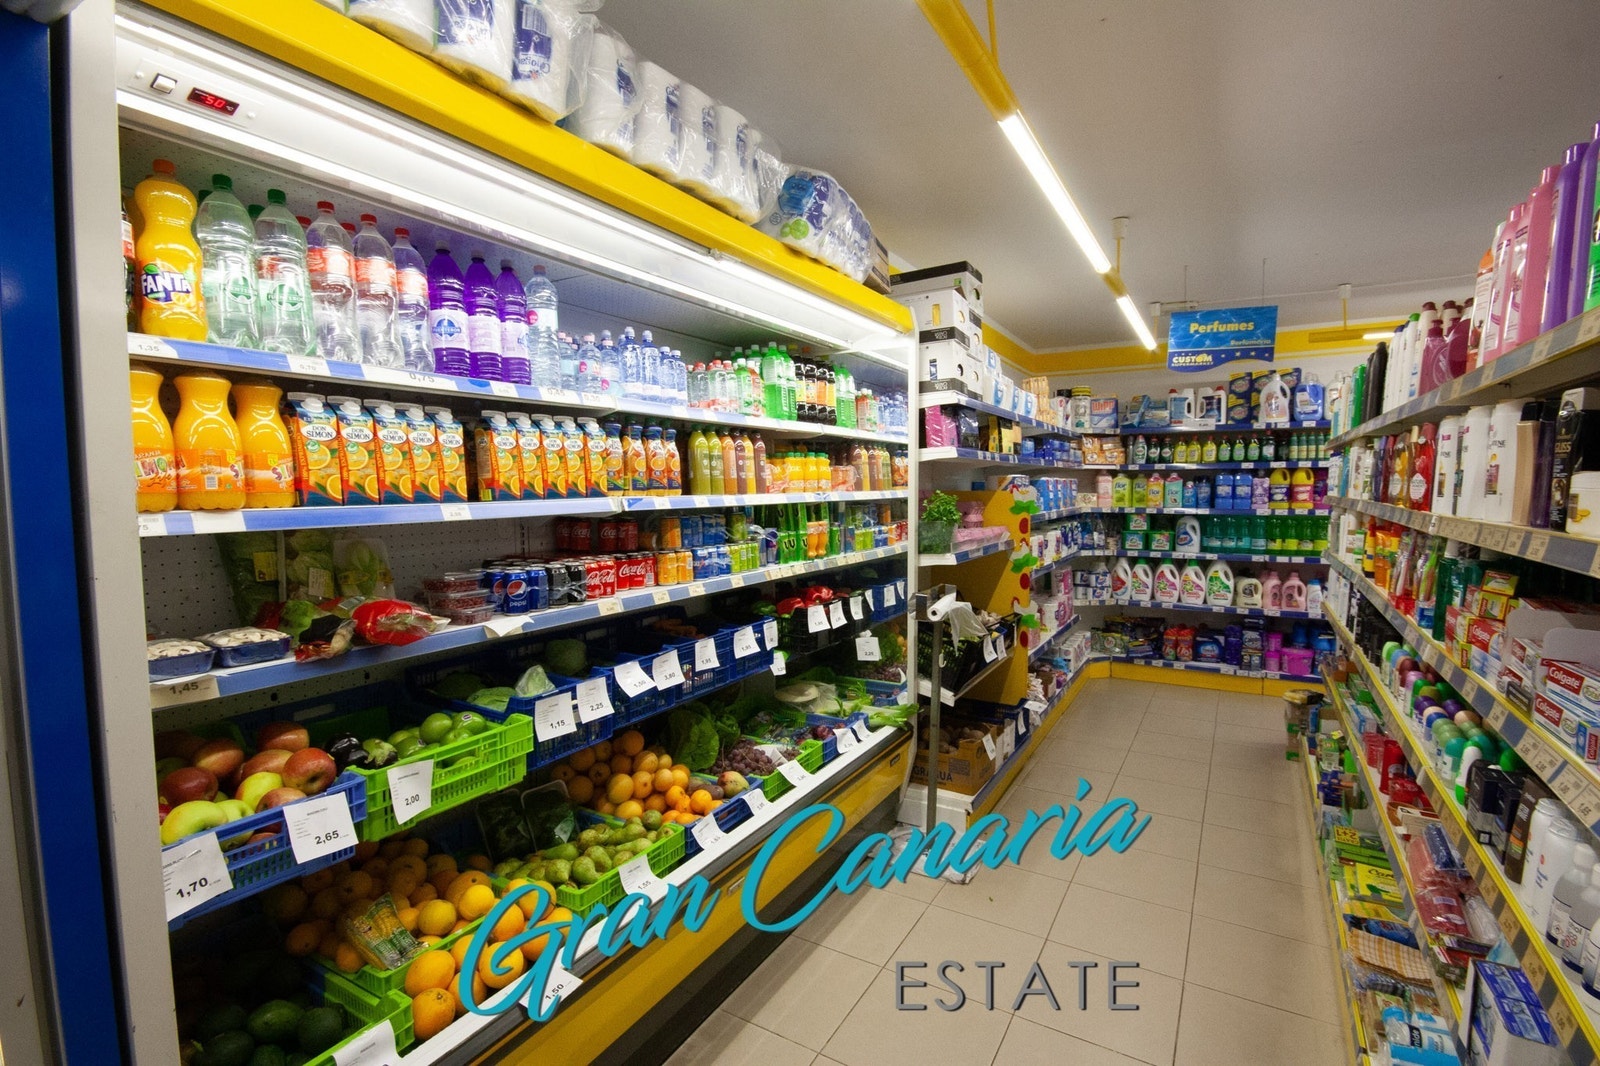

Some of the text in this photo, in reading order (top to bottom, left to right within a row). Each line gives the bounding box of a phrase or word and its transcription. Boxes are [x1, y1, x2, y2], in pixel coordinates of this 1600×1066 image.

[141, 271, 191, 295] FANTA
[1189, 321, 1254, 334] Perfumes
[1172, 353, 1213, 363] CUSTOM
[306, 430, 333, 438] SIMON
[346, 432, 371, 440] SIMON
[1549, 667, 1580, 689] Colgate
[168, 681, 199, 695] 1,45
[589, 702, 604, 712] 2,25
[1535, 698, 1561, 718] Colgate
[550, 719, 566, 730] 1,15
[404, 793, 420, 806] 2,00
[314, 829, 340, 846] 2,65
[175, 876, 209, 899] 1,70
[545, 983, 565, 1001] 1,50
